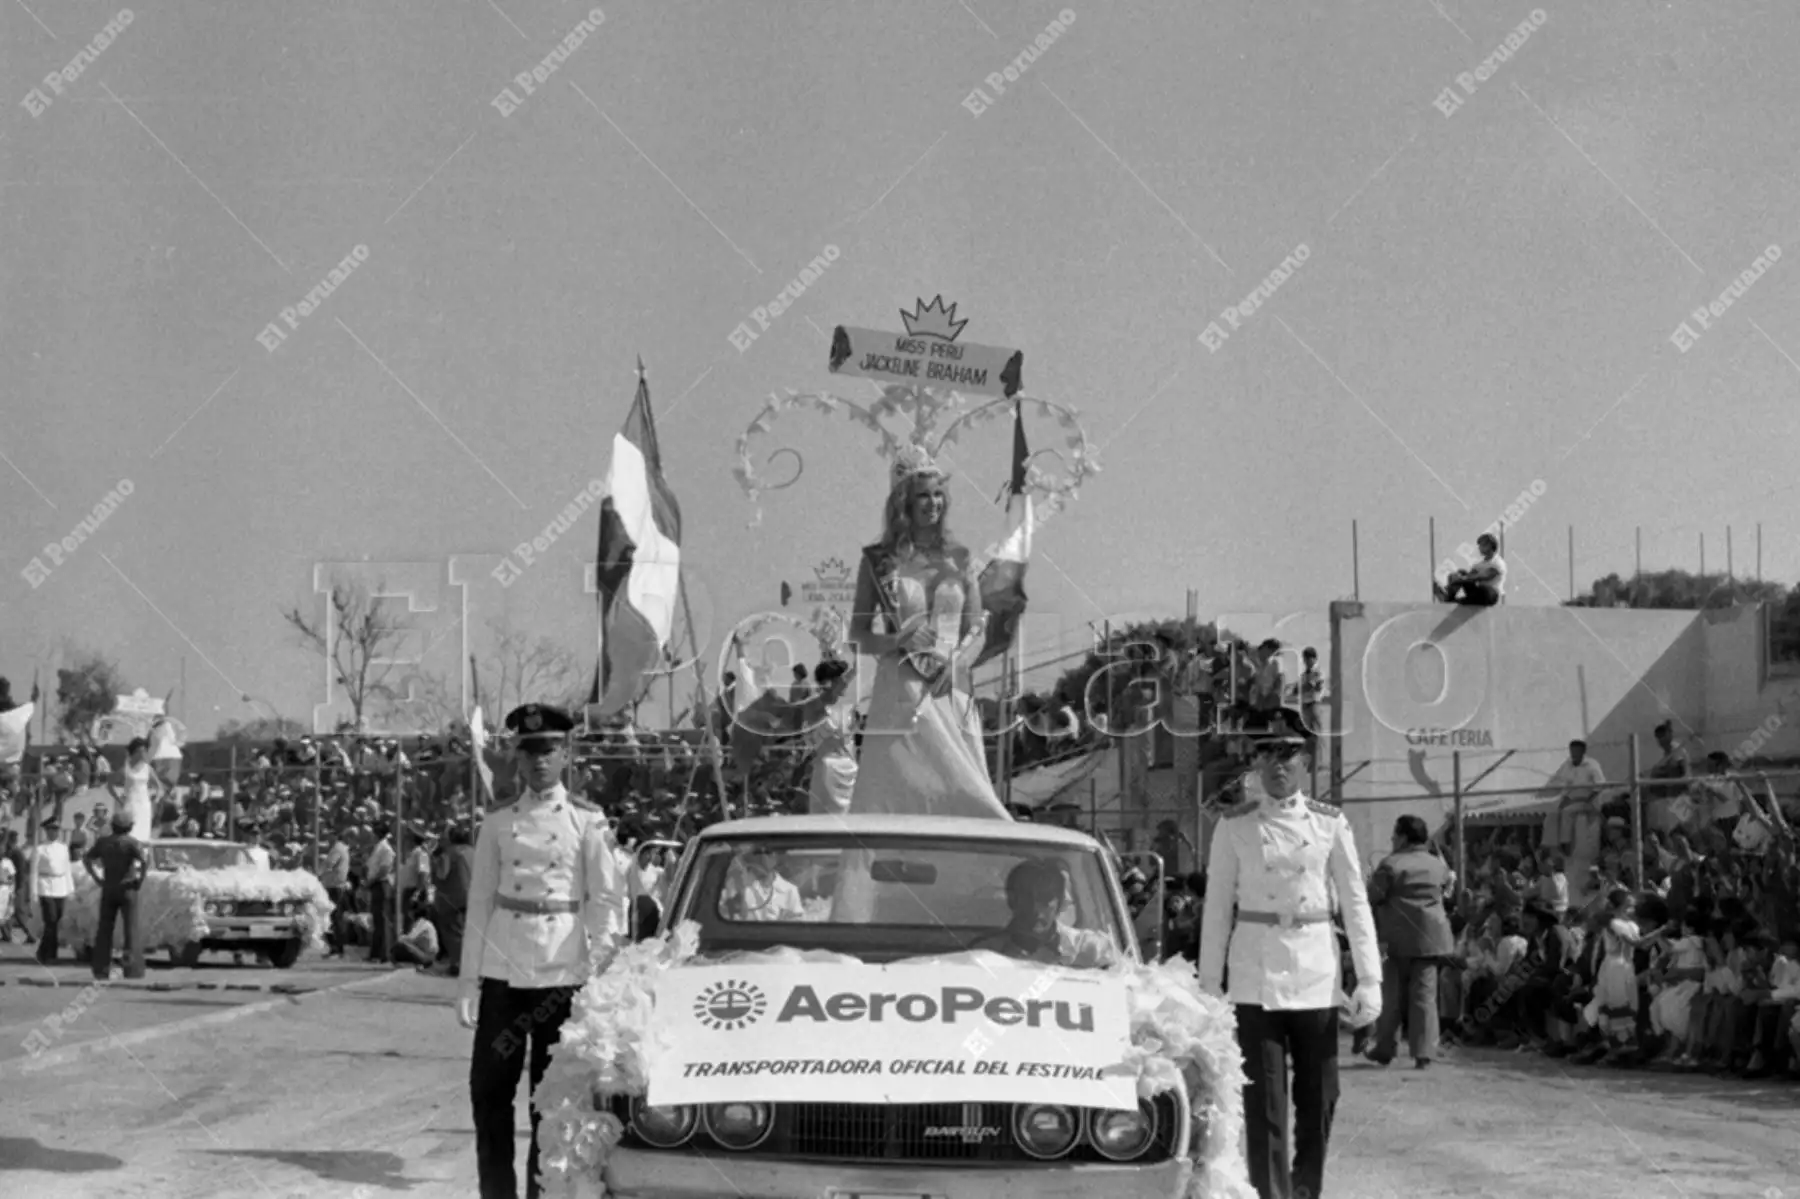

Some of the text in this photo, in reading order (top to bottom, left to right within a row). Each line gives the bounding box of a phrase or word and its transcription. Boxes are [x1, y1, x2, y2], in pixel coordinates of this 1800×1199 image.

[1403, 728, 1493, 748] CAFETERIA
[775, 984, 1095, 1032] AeroPeru
[682, 1059, 882, 1078] TRANSPORTADORA
[888, 1059, 966, 1076] OFICIAL
[973, 1060, 1009, 1076] DEL
